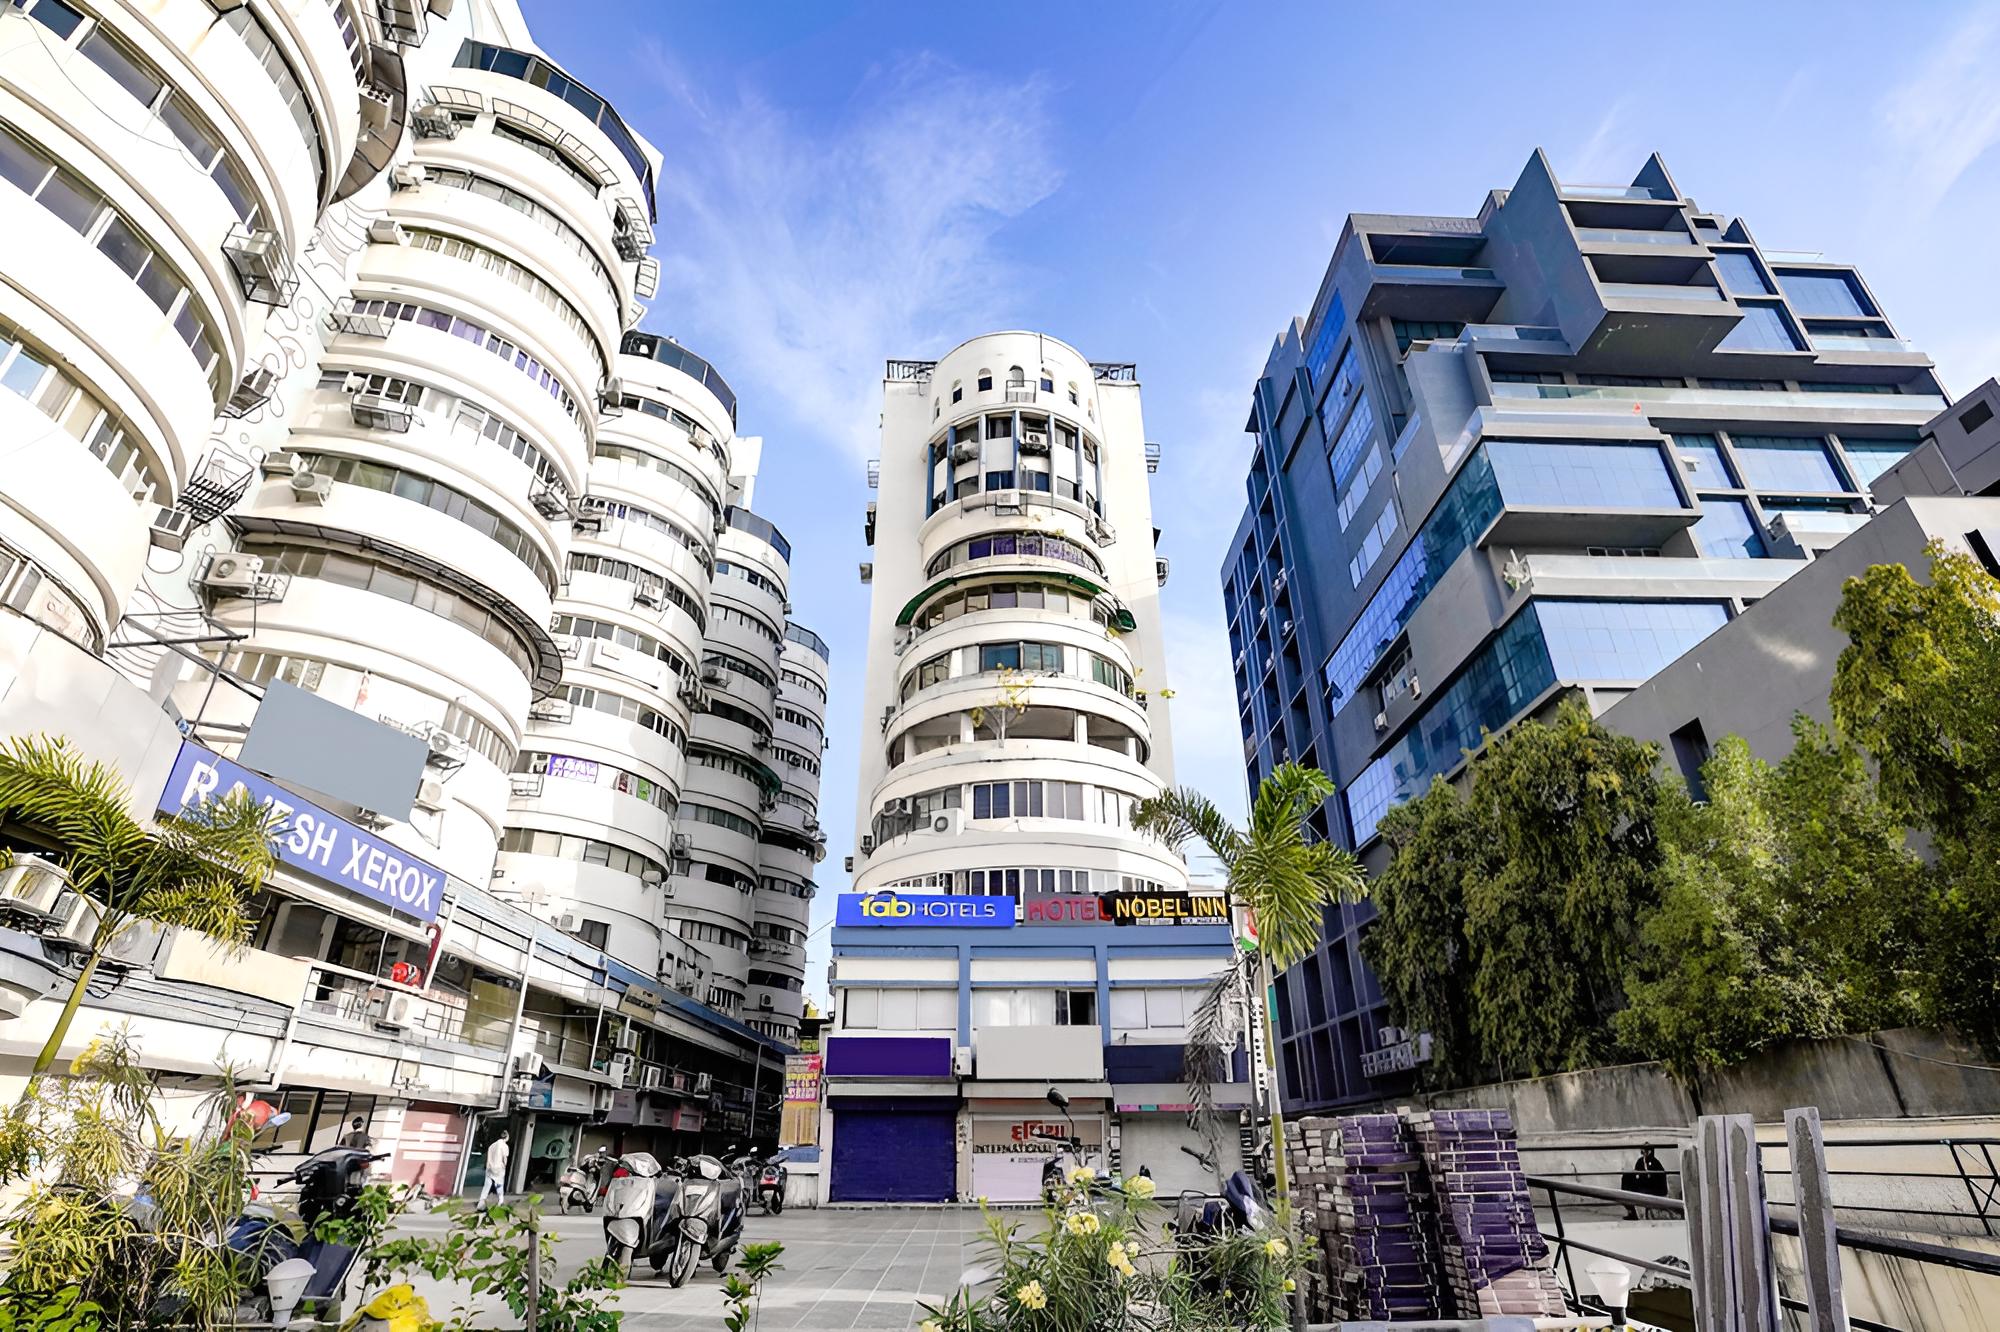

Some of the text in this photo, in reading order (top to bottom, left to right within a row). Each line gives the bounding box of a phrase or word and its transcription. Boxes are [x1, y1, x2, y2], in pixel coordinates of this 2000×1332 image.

[181, 761, 438, 911] RESH XEROX
[1028, 896, 1228, 922] HOTEL NOBEL INN
